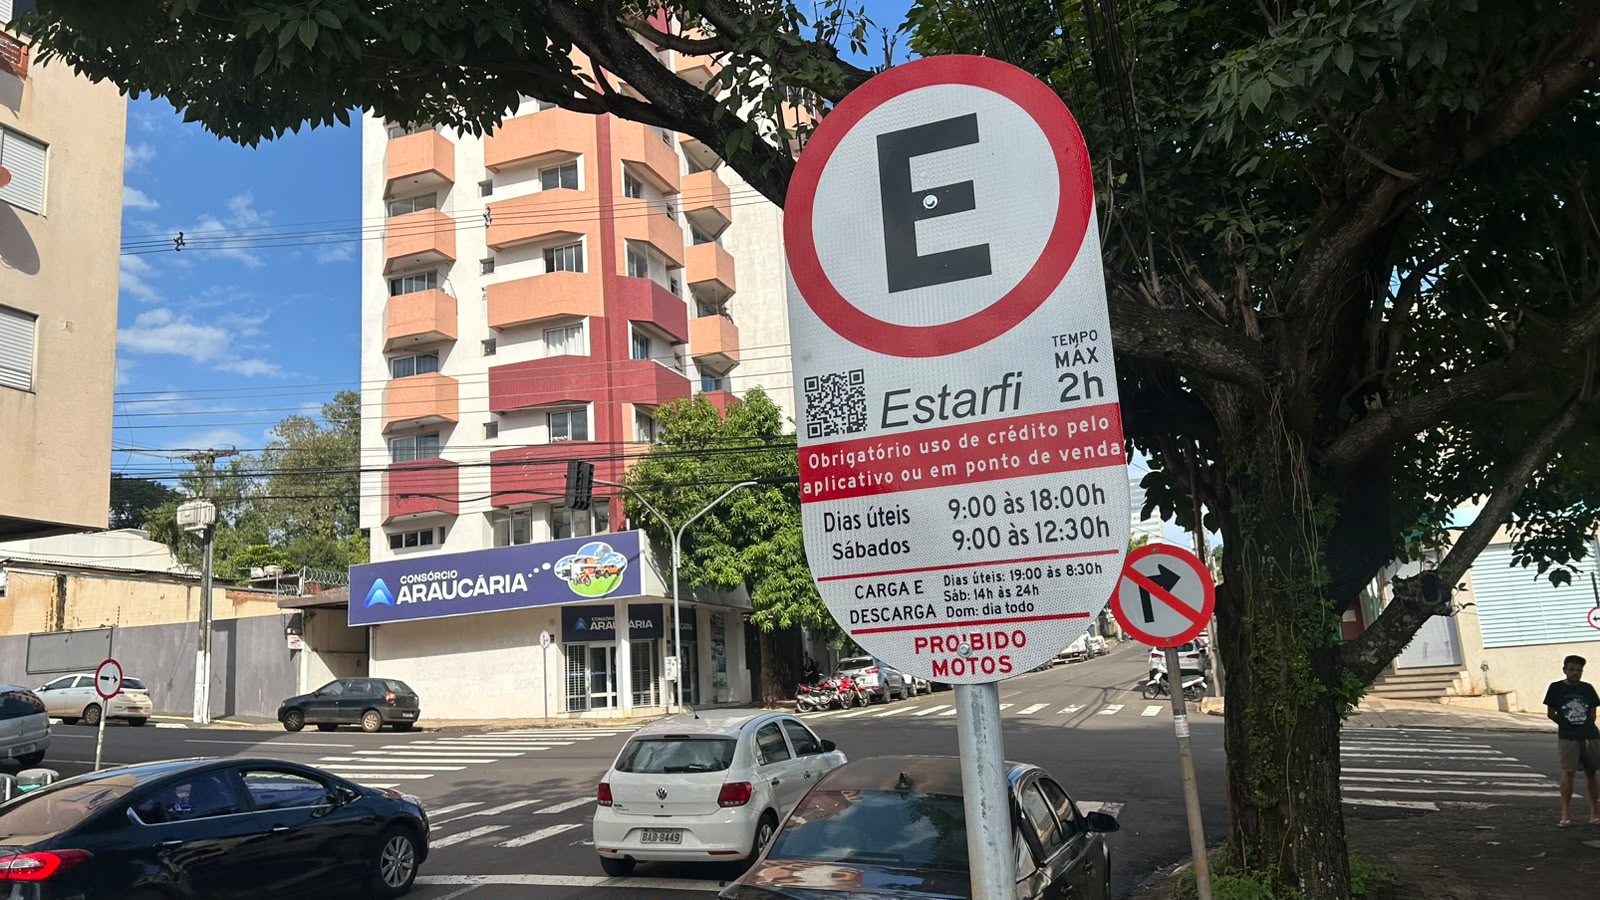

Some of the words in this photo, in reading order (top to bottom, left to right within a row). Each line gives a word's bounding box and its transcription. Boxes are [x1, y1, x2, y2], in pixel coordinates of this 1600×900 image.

[877, 112, 992, 293] E
[1052, 329, 1098, 347] TEMPO
[1054, 345, 1099, 369] MÁX
[1058, 370, 1104, 403] 2h
[881, 371, 1023, 429] Estarfi
[808, 442, 912, 469] Obrigatório
[919, 438, 951, 454] uso
[958, 433, 979, 449] de
[987, 422, 1058, 445] crédito
[1067, 414, 1109, 438] pelo
[803, 472, 894, 496] aplicativo
[901, 468, 922, 483] ou
[930, 463, 957, 478] em
[966, 453, 1020, 477] ponto
[1028, 448, 1051, 466] de
[1059, 440, 1121, 462] venda
[824, 511, 862, 533] Dias
[867, 504, 911, 529] úteis
[948, 494, 997, 520] 9:00
[1004, 492, 1025, 515] às
[1030, 483, 1106, 512] 18:00h
[832, 538, 911, 560] Sábados
[952, 525, 1001, 550] 9:00
[1008, 523, 1030, 546] às
[1035, 516, 1110, 543] 12:30h
[400, 570, 458, 585] CONSÓRCIO
[943, 573, 968, 587] Dias
[972, 570, 1006, 585] úteis:
[1010, 567, 1042, 581] 19:00
[1047, 565, 1061, 579] às
[1066, 562, 1102, 577] 8:30h
[396, 573, 528, 605] ARAUCÁRIA
[855, 582, 909, 600] CARGA
[914, 580, 924, 594] E
[943, 588, 971, 602] Sáb:
[974, 587, 994, 600] 14h
[998, 585, 1012, 598] às
[1016, 584, 1039, 597] 24h
[850, 603, 937, 625] DESCARGA
[946, 605, 979, 618] Dom:
[982, 603, 1002, 616] dia
[1005, 600, 1034, 613] todo
[932, 655, 1013, 677] MOTOS
